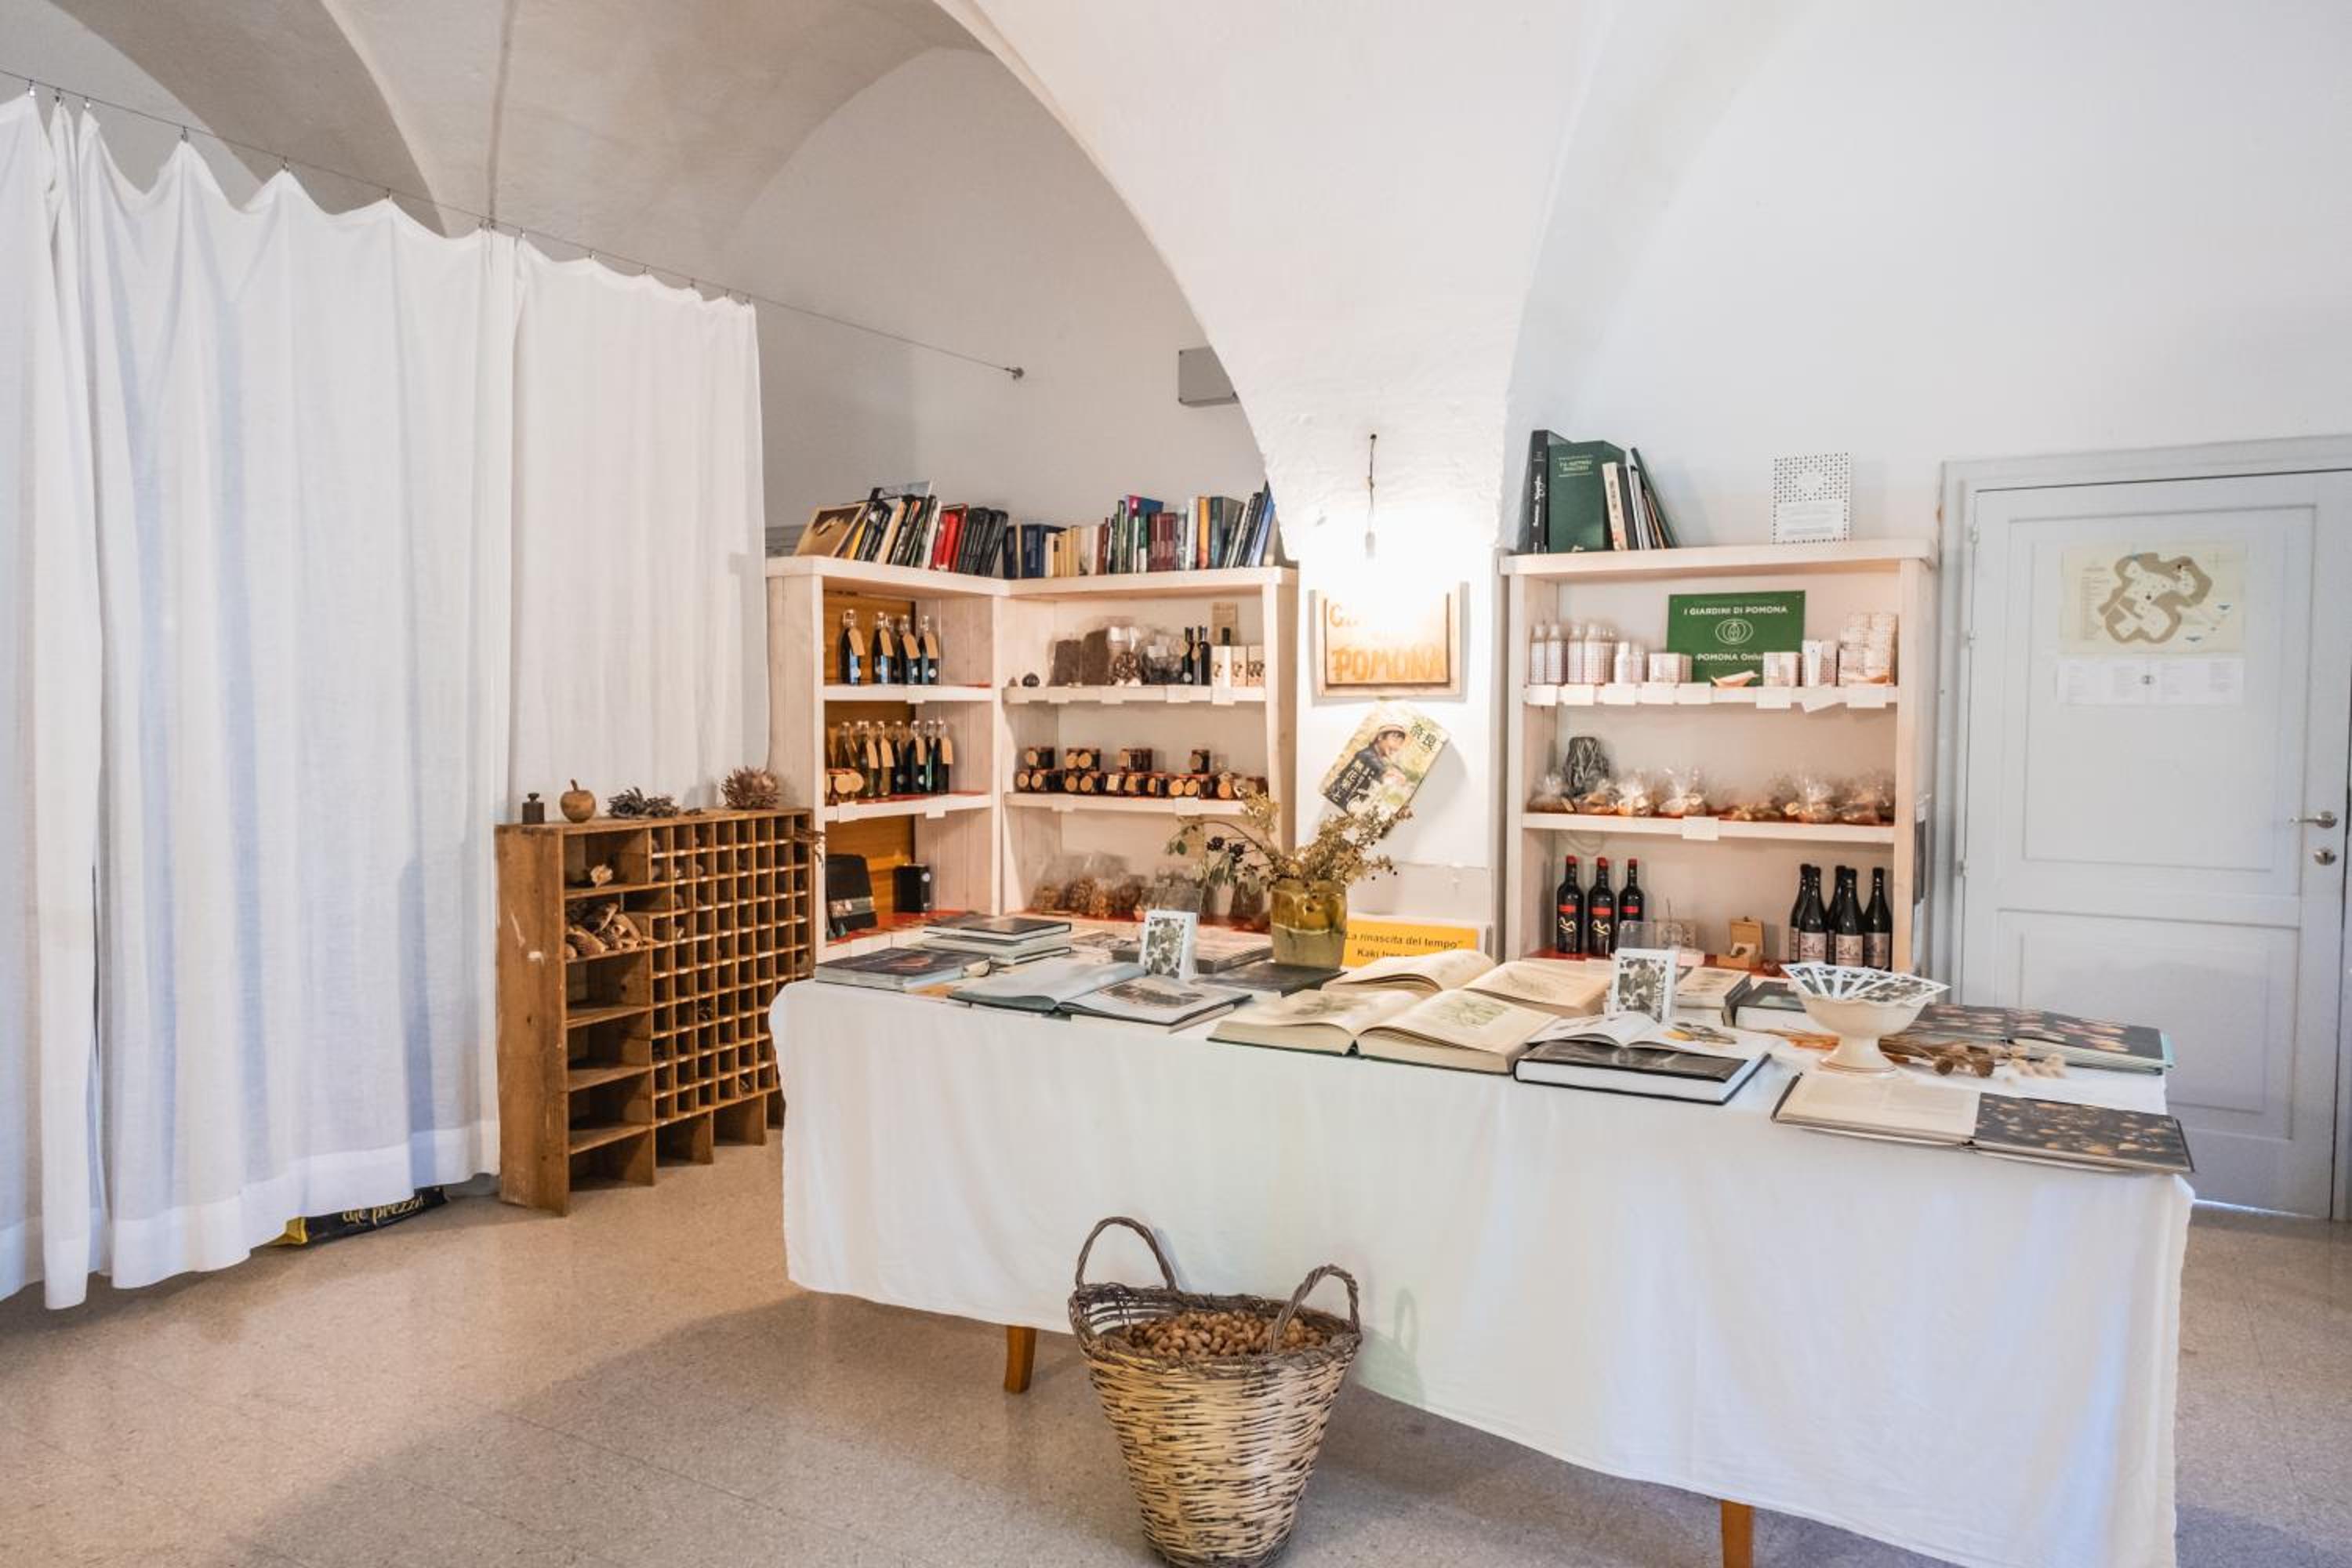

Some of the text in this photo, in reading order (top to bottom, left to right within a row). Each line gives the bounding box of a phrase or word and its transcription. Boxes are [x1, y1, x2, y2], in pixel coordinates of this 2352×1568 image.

[1745, 605, 1788, 614] POMONA
[1332, 648, 1444, 681] POMONA
[1360, 933, 1403, 945] rinascita
[1406, 937, 1421, 946] del
[1357, 948, 1379, 958] Kaki
